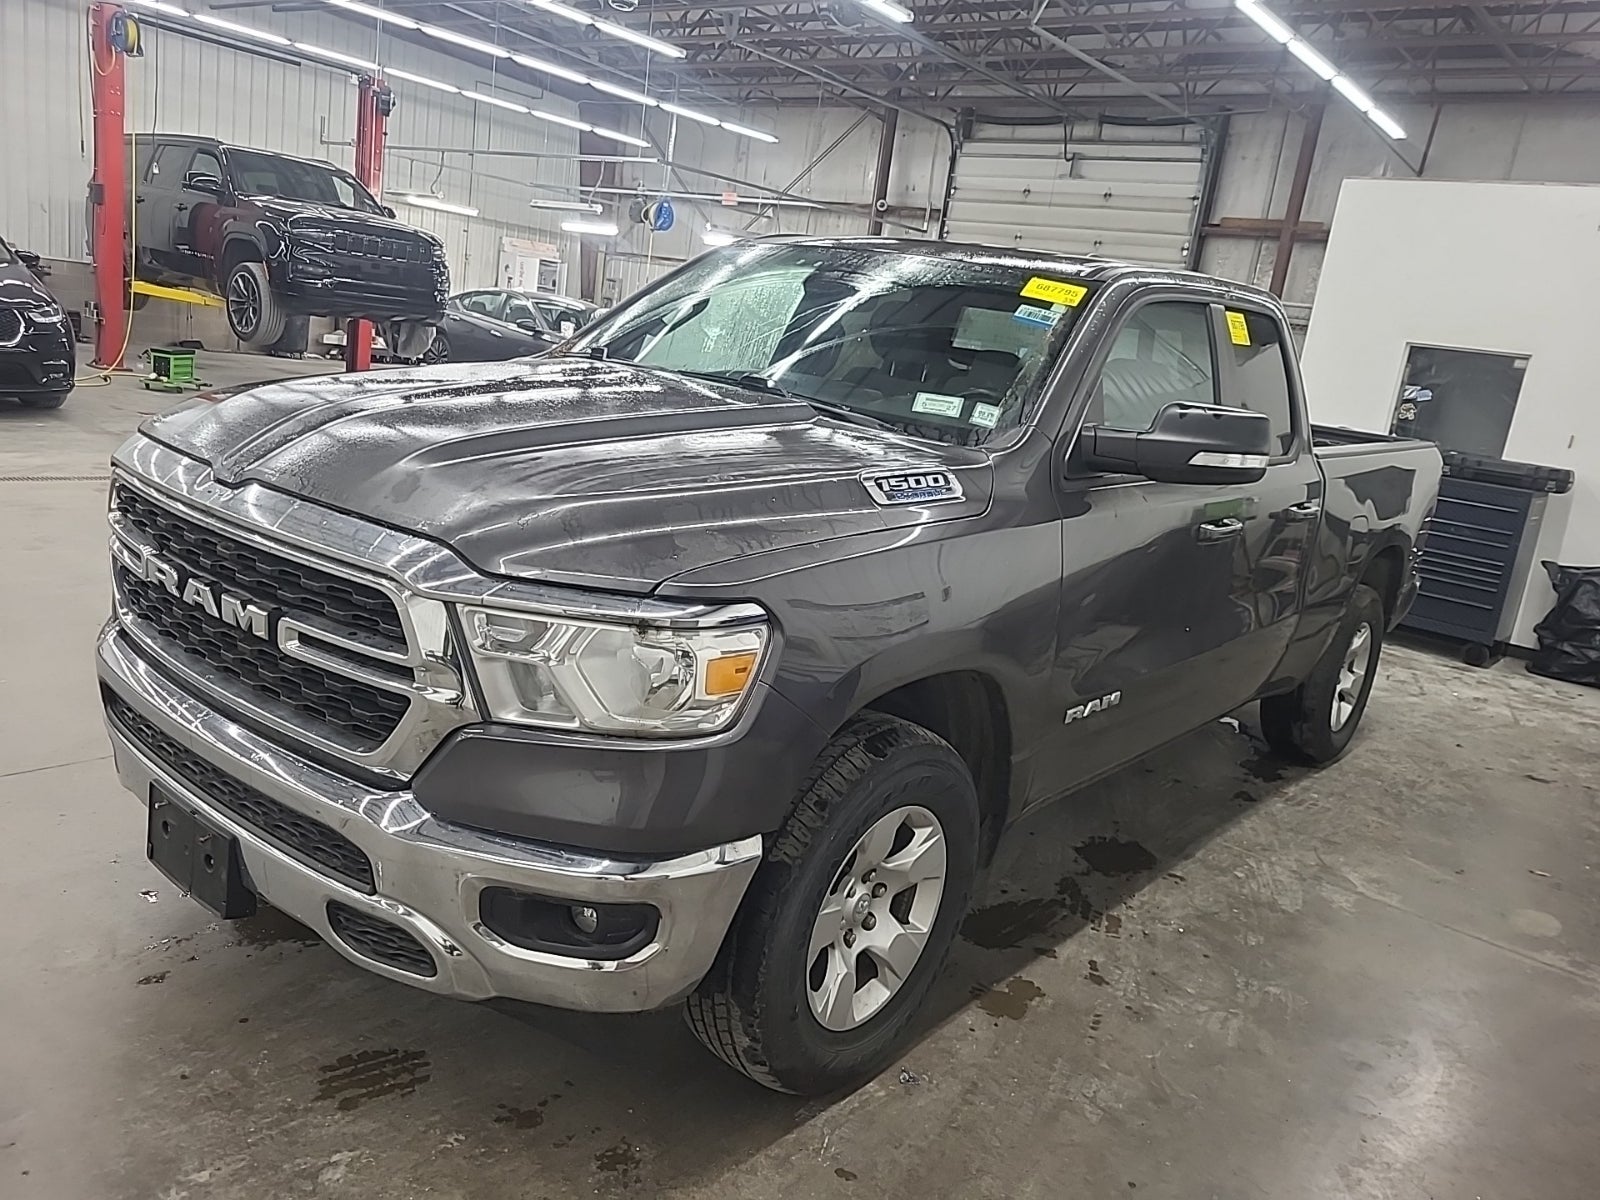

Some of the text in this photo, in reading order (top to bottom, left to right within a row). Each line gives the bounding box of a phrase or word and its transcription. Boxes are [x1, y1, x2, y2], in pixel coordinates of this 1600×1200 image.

[877, 474, 946, 492] 1500
[147, 554, 270, 641] RAM
[1064, 690, 1121, 724] RAM
